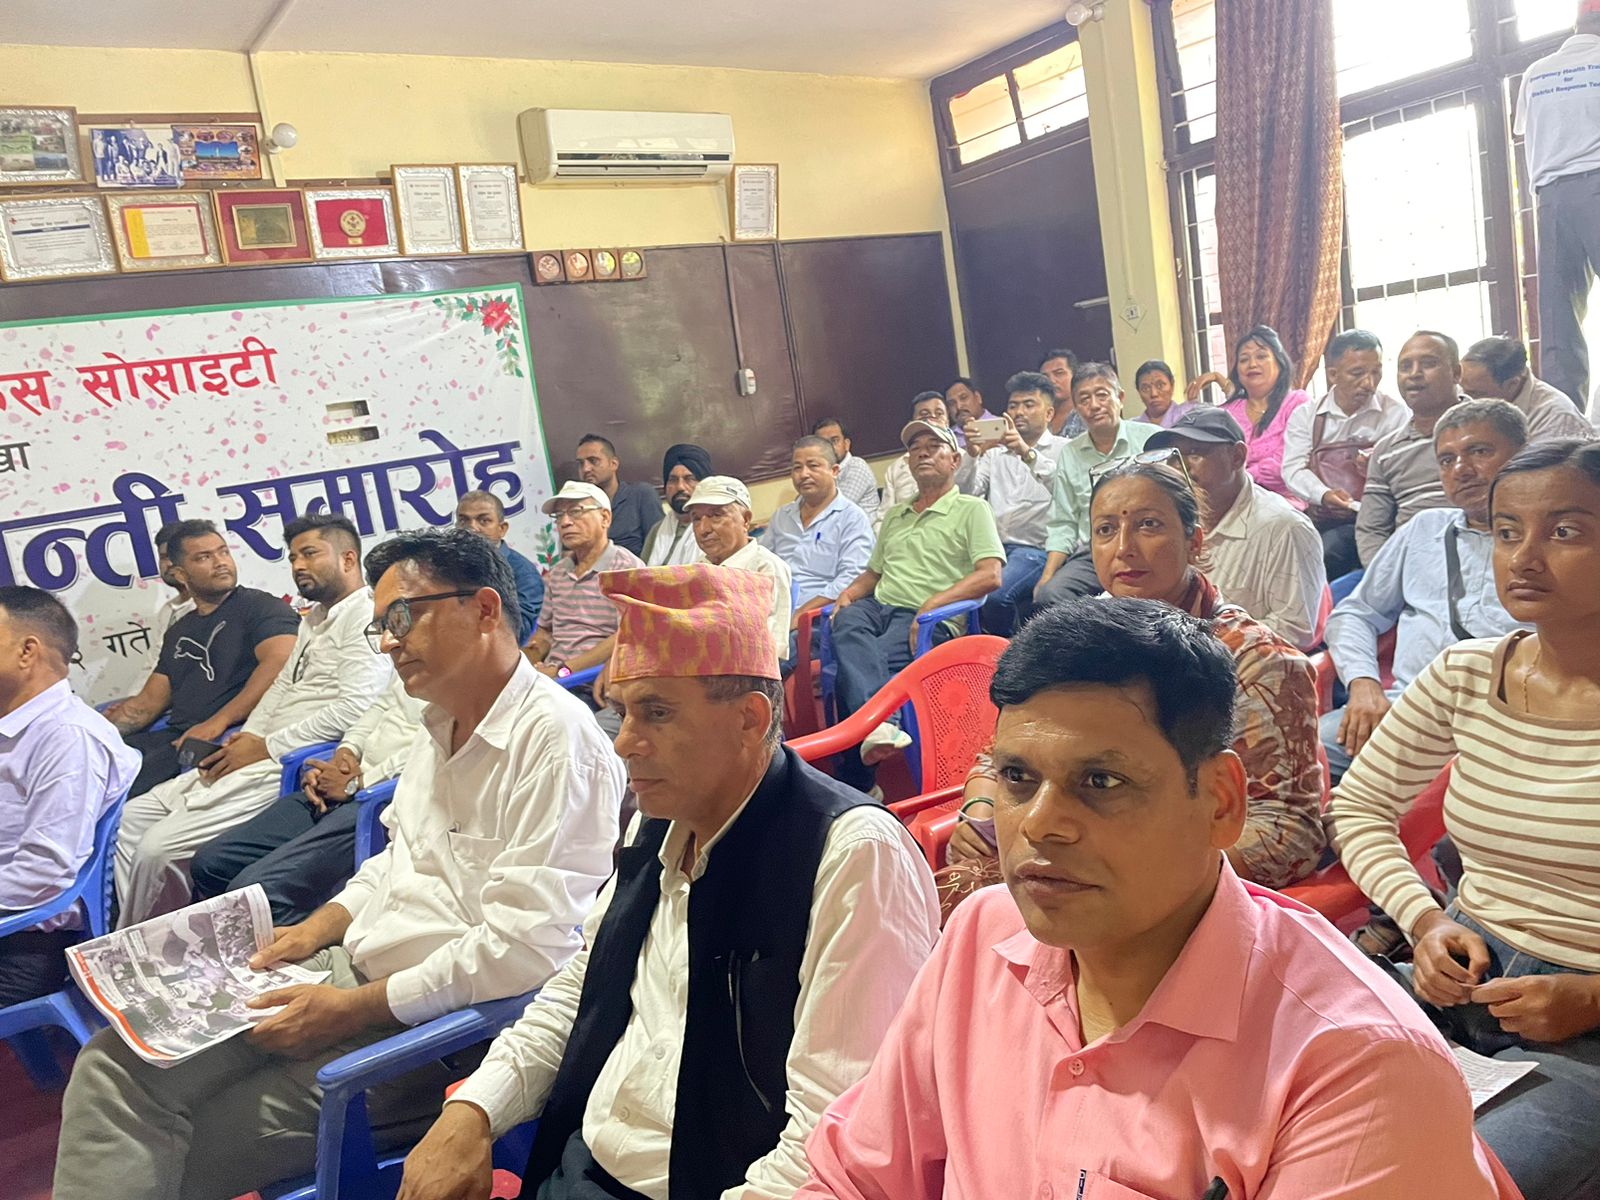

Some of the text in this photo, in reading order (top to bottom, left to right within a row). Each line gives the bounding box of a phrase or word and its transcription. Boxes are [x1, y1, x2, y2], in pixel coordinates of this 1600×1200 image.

[0, 336, 278, 416] स सोसाइटी
[215, 429, 525, 562] समारोह
[102, 621, 152, 658] गते
